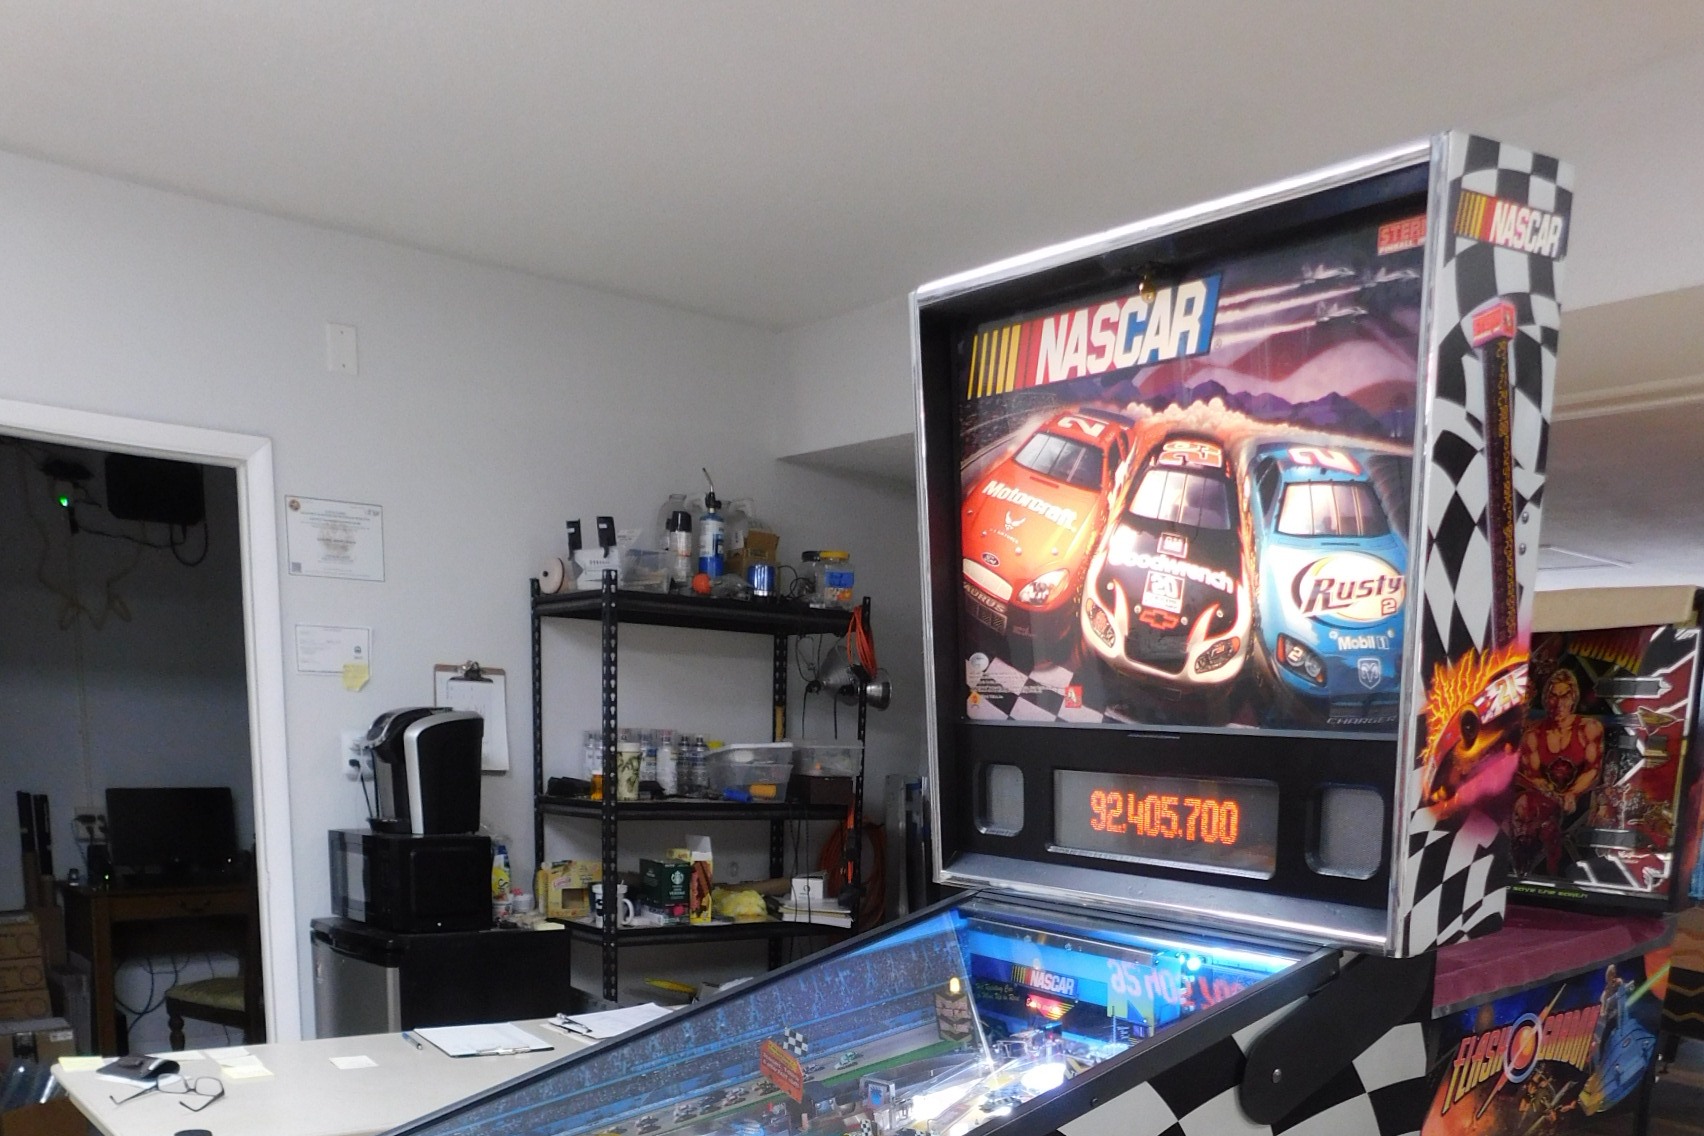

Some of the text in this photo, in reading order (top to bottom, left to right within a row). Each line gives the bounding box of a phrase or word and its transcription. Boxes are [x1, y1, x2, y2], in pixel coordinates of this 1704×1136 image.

[1489, 201, 1563, 258] NASCAR
[1035, 279, 1206, 386] NASCAR
[982, 480, 1078, 532] Motorcraft
[1303, 574, 1405, 617] Rusty
[1381, 598, 1399, 616] 2
[1337, 635, 1375, 651] Mobil
[1326, 714, 1398, 726] CHARGER
[1030, 969, 1075, 996] NASCAR
[1441, 1025, 1511, 1115] FLASH
